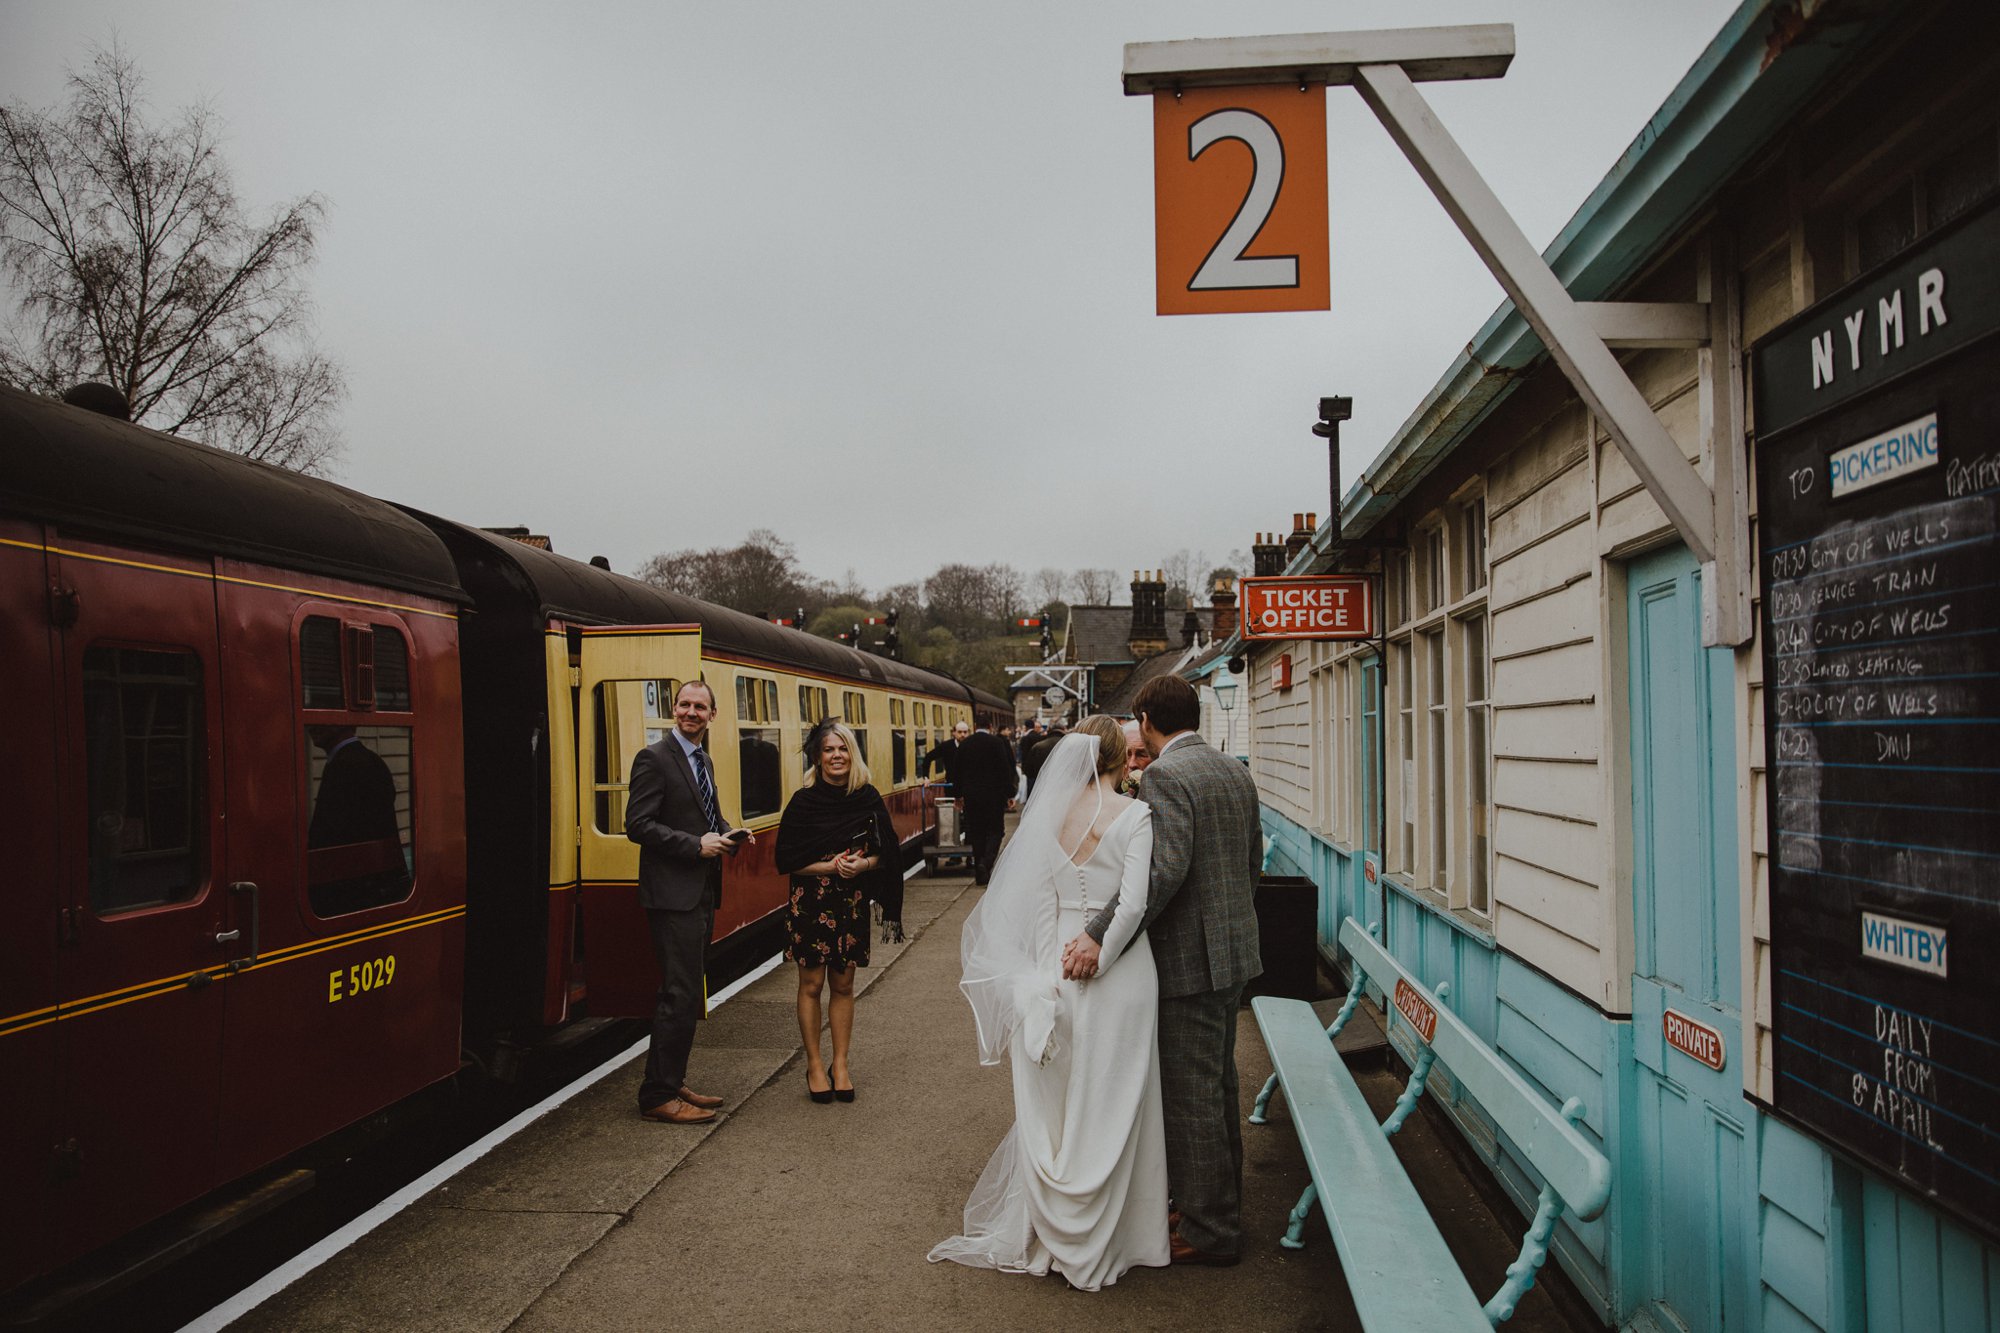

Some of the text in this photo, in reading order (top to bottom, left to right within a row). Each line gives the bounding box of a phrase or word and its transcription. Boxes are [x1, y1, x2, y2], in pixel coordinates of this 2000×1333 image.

[1186, 107, 1300, 291] 2
[1811, 268, 1947, 389] NYMR
[1830, 423, 1938, 491] PICKERING
[1789, 467, 1814, 500] TO
[1811, 547, 1839, 569] CITY
[1846, 536, 1875, 563] OF
[1886, 517, 1950, 551] WELLS
[1261, 588, 1349, 608] TICKET
[1872, 563, 1937, 593] TRAIN
[1261, 608, 1348, 628] OFFICE
[1814, 622, 1847, 644] CITY
[1851, 612, 1883, 640] OF
[1890, 605, 1950, 636] WELLS
[1858, 656, 1923, 676] SEATING
[1814, 693, 1845, 714] CITY
[1854, 693, 1880, 712] OF
[1887, 694, 1938, 716] WELLS
[1875, 732, 1911, 761] DMU
[1864, 918, 1947, 967] WHITBY
[328, 955, 396, 1003] E 5029
[1667, 1015, 1717, 1064] PRIVATE
[1875, 1005, 1932, 1056] DAILY
[1884, 1048, 1936, 1094] FROM
[1873, 1083, 1944, 1152] APRIL
